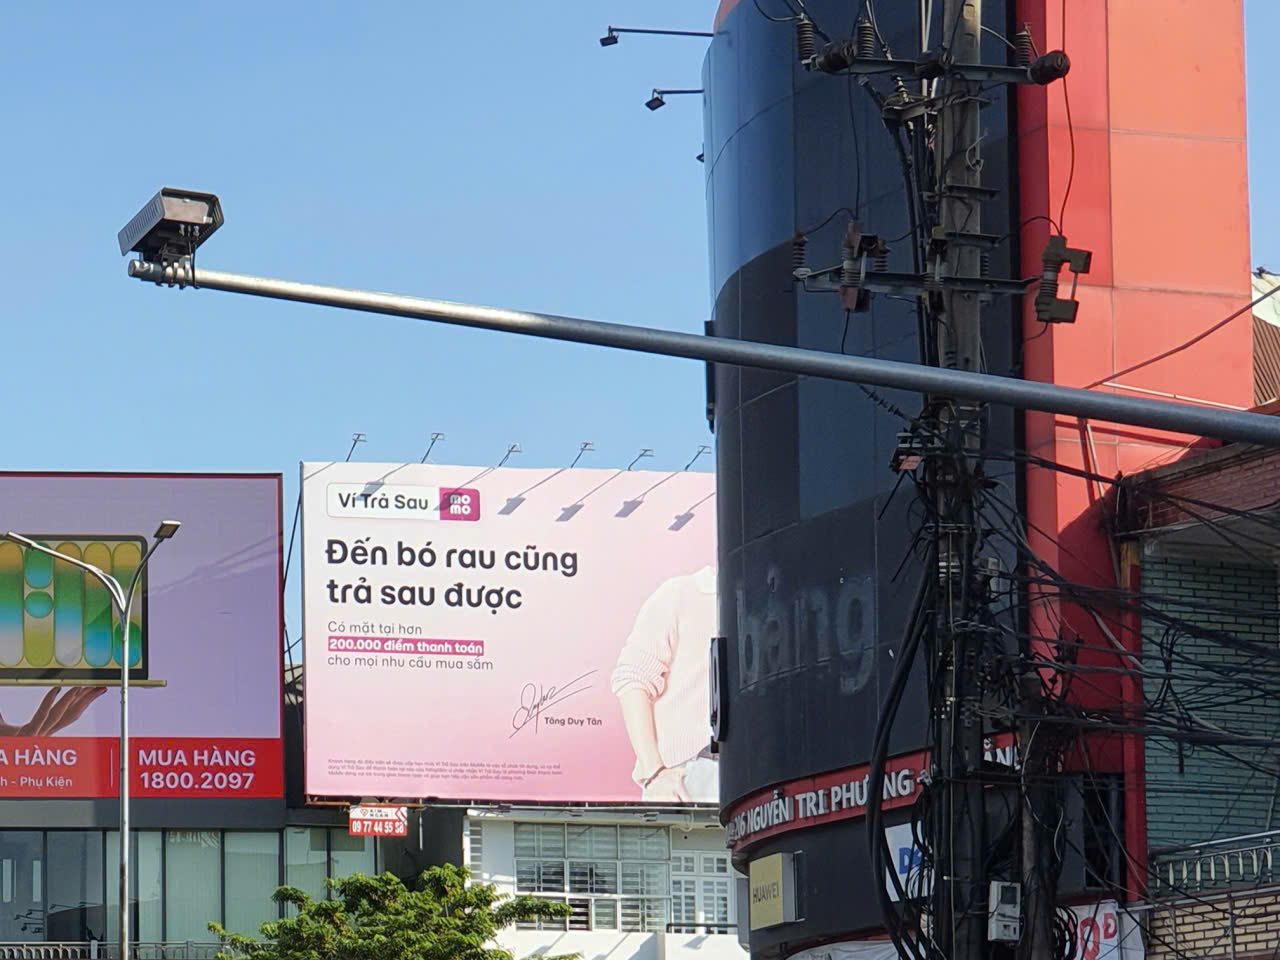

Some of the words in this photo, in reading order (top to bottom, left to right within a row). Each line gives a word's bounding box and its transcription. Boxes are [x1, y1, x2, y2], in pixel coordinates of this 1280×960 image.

[338, 492, 356, 508] Ví
[362, 492, 389, 509] Trả
[395, 494, 429, 510] Sau
[325, 537, 388, 565] Đến
[397, 540, 437, 567] bó
[446, 548, 496, 569] rau
[504, 545, 578, 577] cũng
[326, 576, 372, 604] trả
[380, 585, 436, 606] sau
[444, 582, 522, 615] được
[328, 620, 346, 633] Có
[349, 621, 376, 635] mặt
[379, 623, 395, 636] tại
[398, 624, 422, 635] hơn
[329, 639, 382, 651] 200.000
[416, 640, 453, 653] thanh
[455, 640, 483, 654] toán
[328, 655, 351, 666] cho
[355, 656, 378, 669] mọi
[382, 656, 405, 667] nhu
[435, 659, 463, 669] mua
[568, 717, 586, 728] Duy
[15, 744, 77, 766] HÀNG
[138, 750, 188, 766] MUA
[193, 745, 256, 767] HÀNG
[20, 776, 43, 789] Phụ
[46, 776, 73, 788] Kiện
[140, 772, 254, 789] 1800.2097
[795, 790, 825, 818] TRI
[831, 768, 911, 812] PHƯNG
[363, 821, 372, 833] 77
[373, 821, 383, 833] 44
[752, 882, 780, 904] HUAWEI
